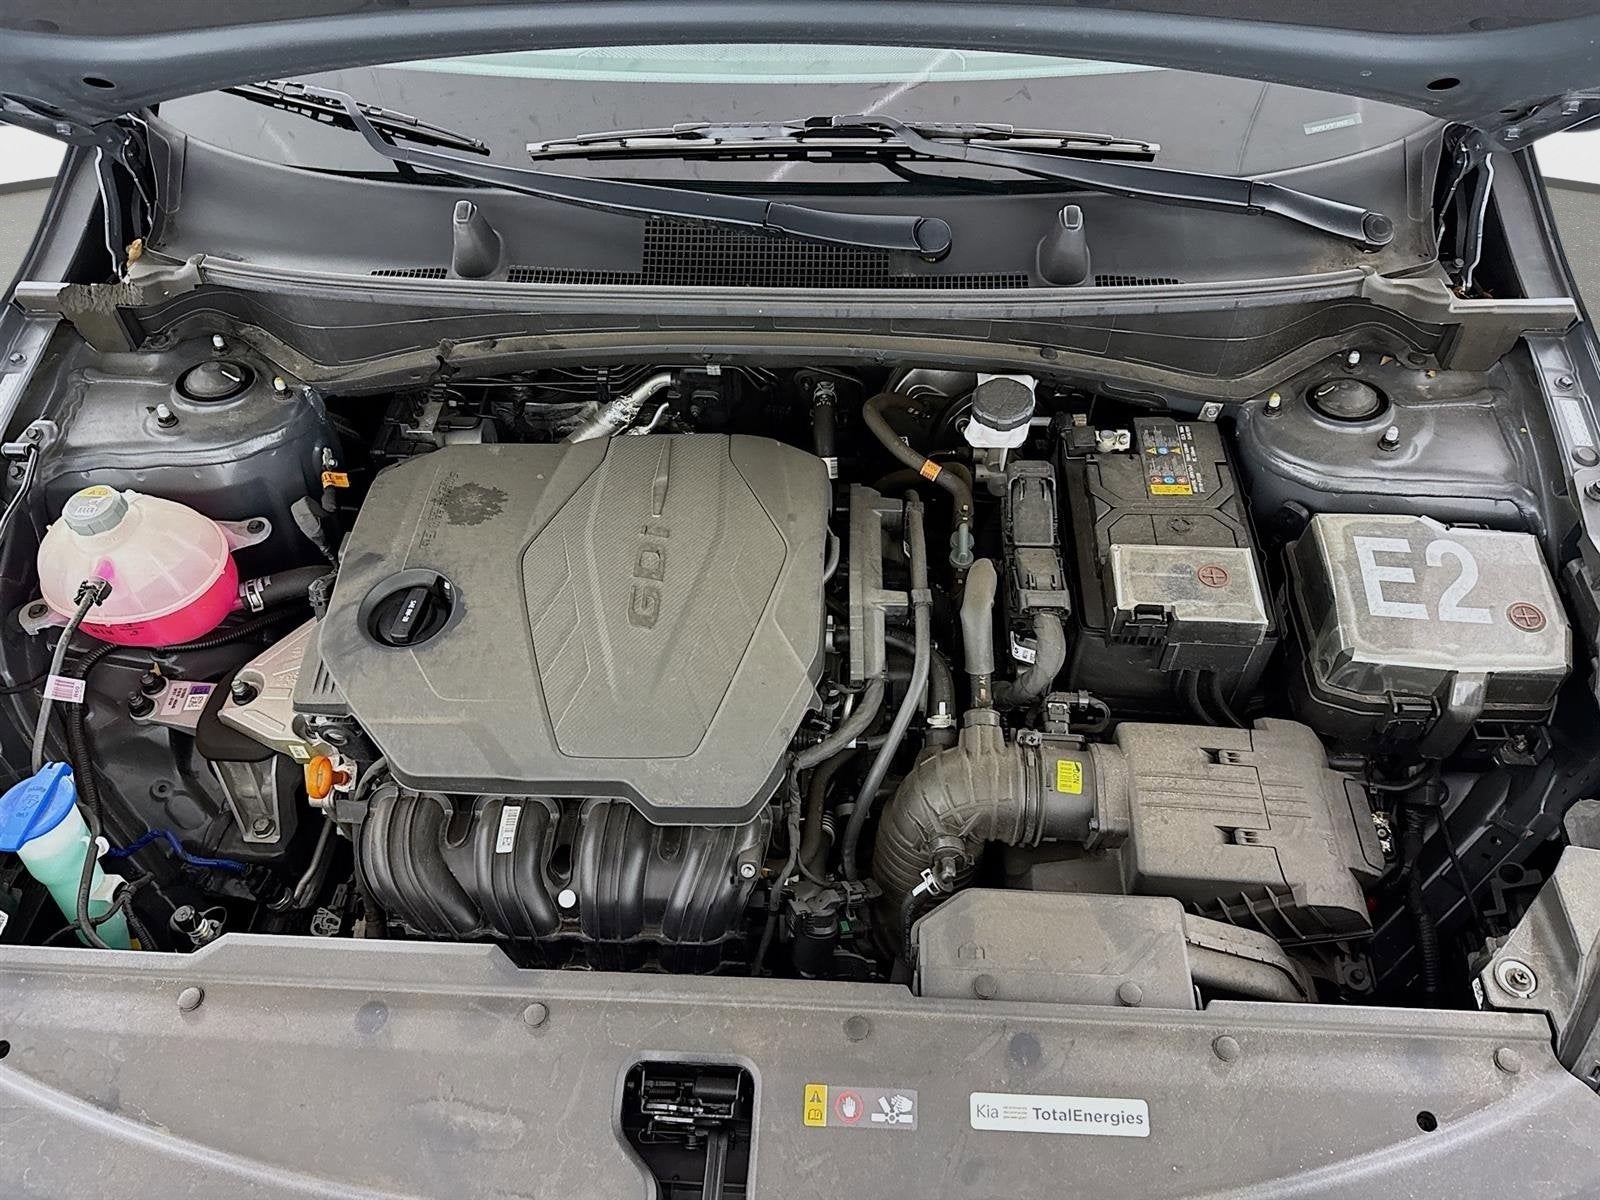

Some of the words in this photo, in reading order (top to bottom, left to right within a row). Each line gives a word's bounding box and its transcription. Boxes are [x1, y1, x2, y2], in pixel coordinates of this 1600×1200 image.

[1353, 535, 1493, 624] E2
[975, 1104, 999, 1119] Kia
[1032, 1107, 1144, 1126] TotalEnergies
